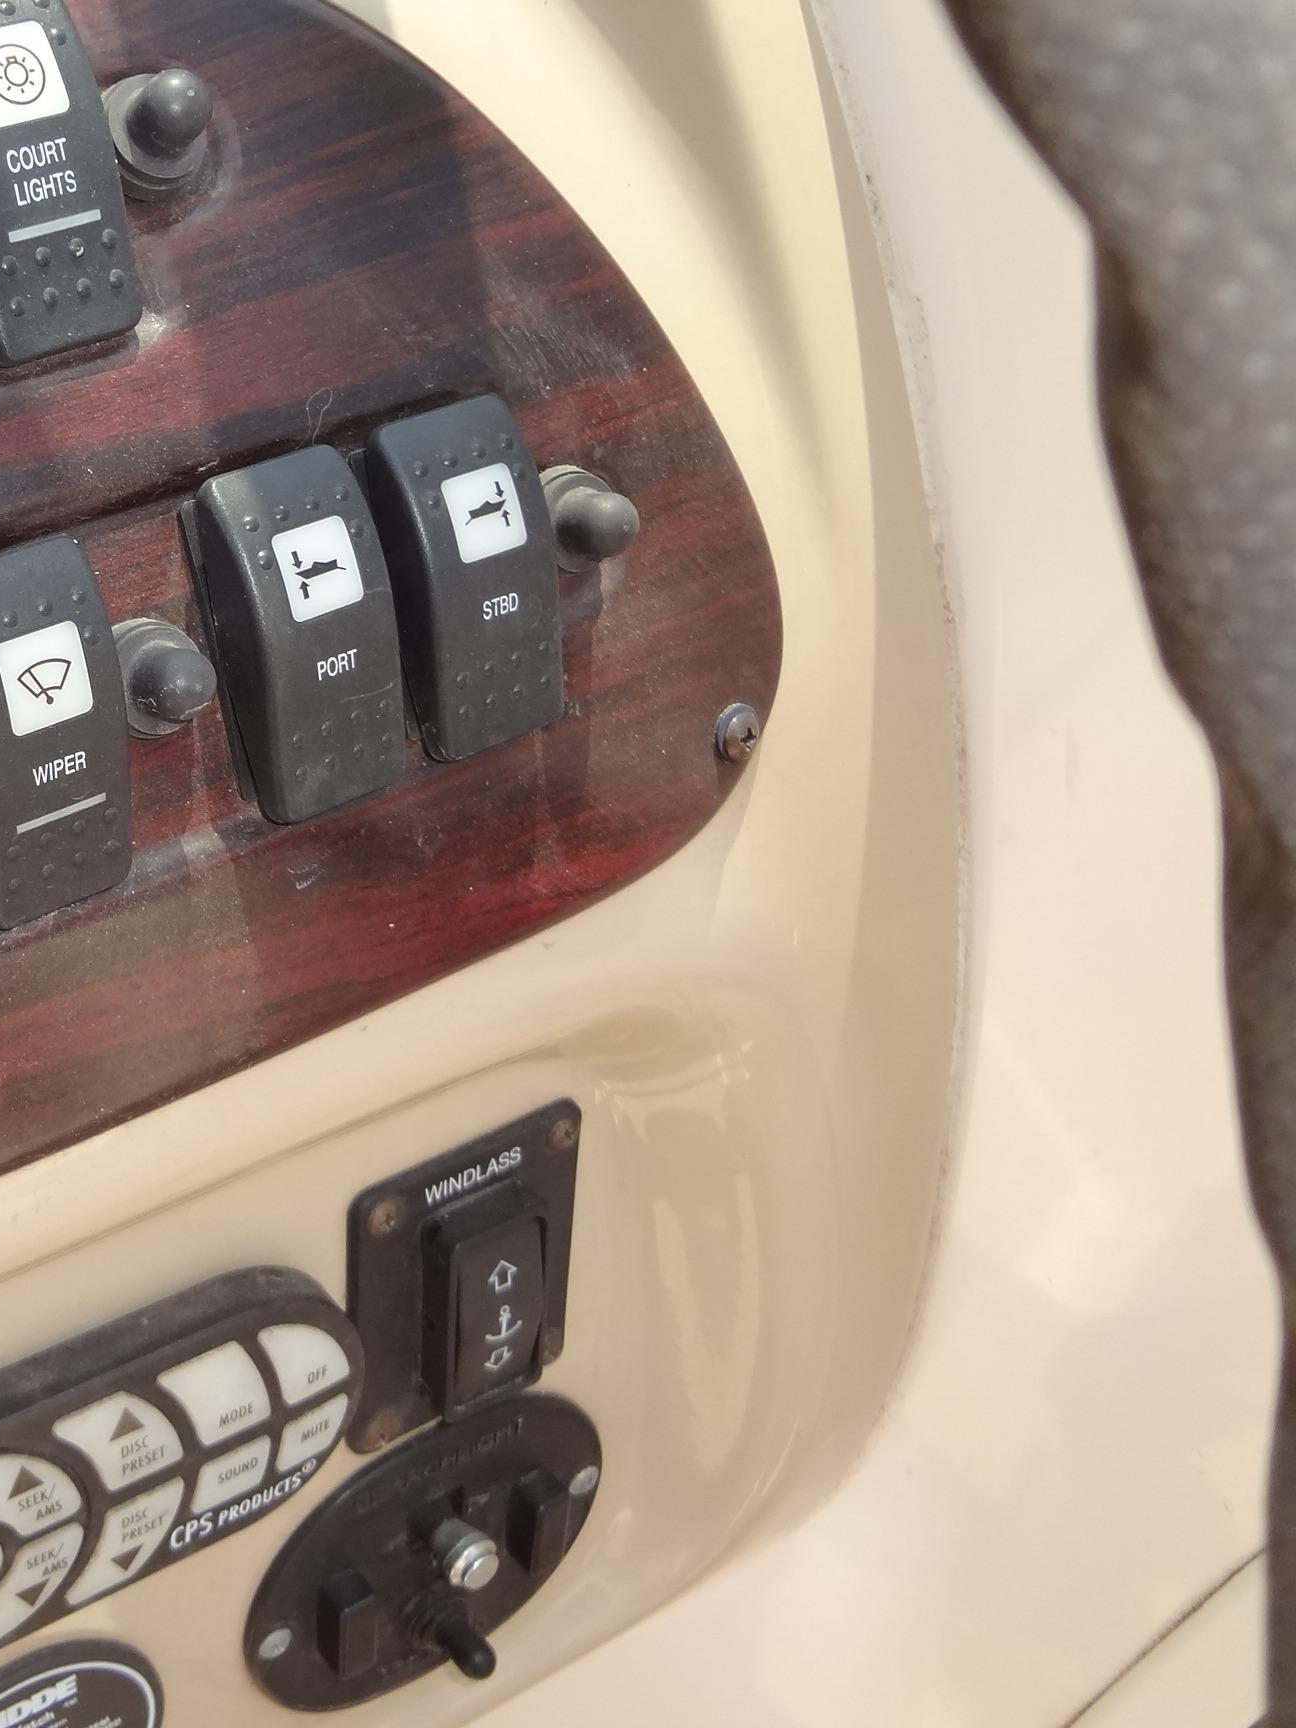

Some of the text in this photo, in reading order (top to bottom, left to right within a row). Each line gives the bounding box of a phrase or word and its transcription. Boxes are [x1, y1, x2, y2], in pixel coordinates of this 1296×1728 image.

[6, 137, 68, 174] COURT
[14, 170, 77, 206] LIGHTS
[482, 592, 519, 620] STBD
[316, 649, 358, 681] PORT
[32, 751, 87, 787] WIPER
[425, 1146, 522, 1206] WINDLASS
[307, 1364, 329, 1385] OFF
[218, 1401, 254, 1428] MODE
[300, 1417, 331, 1443] MUTE
[120, 1435, 149, 1459] DISC
[121, 1445, 166, 1476] PRESET
[217, 1457, 259, 1485] SOUND
[35, 1500, 64, 1521] AMS
[121, 1508, 149, 1529] DISC
[121, 1515, 164, 1544] PRESET
[169, 1512, 214, 1551] CPS
[40, 1557, 69, 1578] AMS
